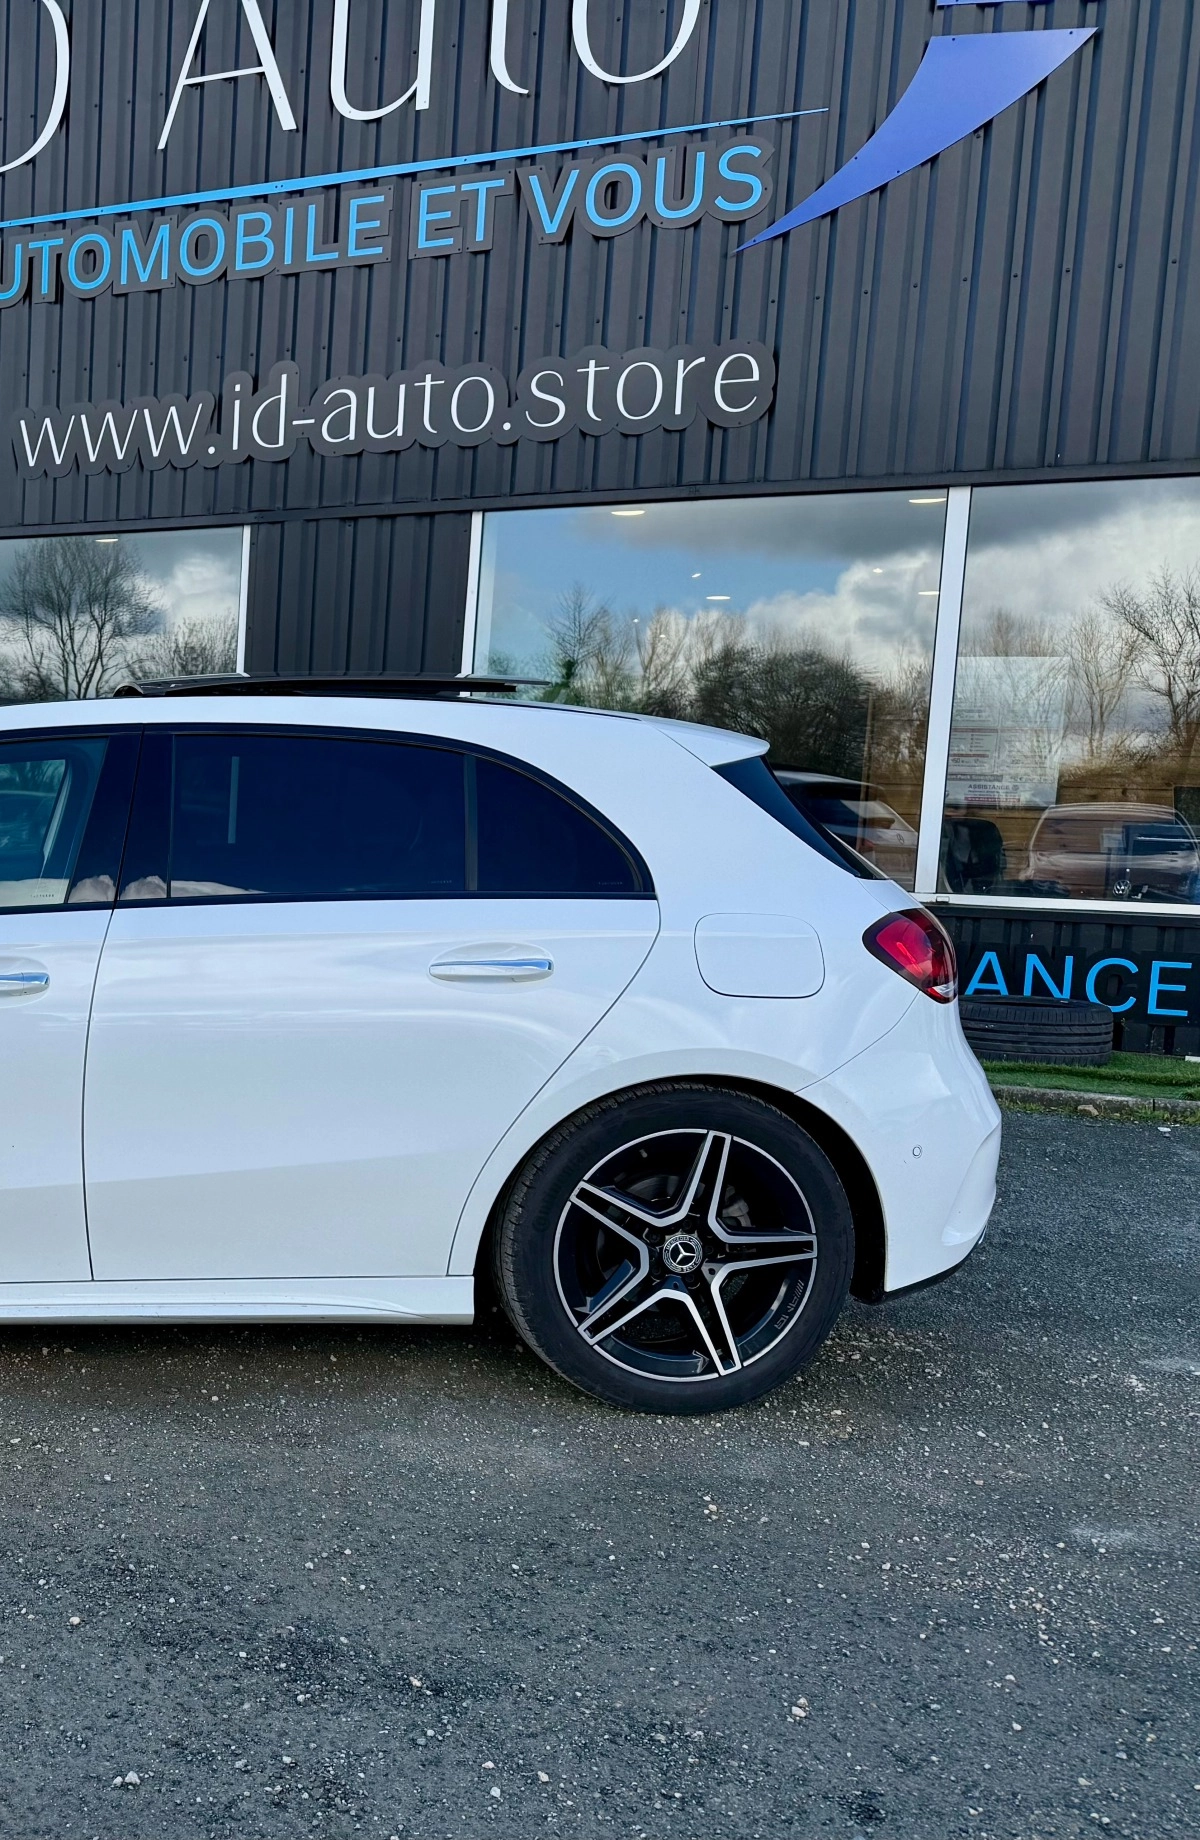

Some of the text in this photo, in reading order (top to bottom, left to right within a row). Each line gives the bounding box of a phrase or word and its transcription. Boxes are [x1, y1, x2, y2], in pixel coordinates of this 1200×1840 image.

[417, 178, 505, 249] ET
[528, 145, 764, 234] VOUS
[19, 353, 761, 467] www.id-auto.store
